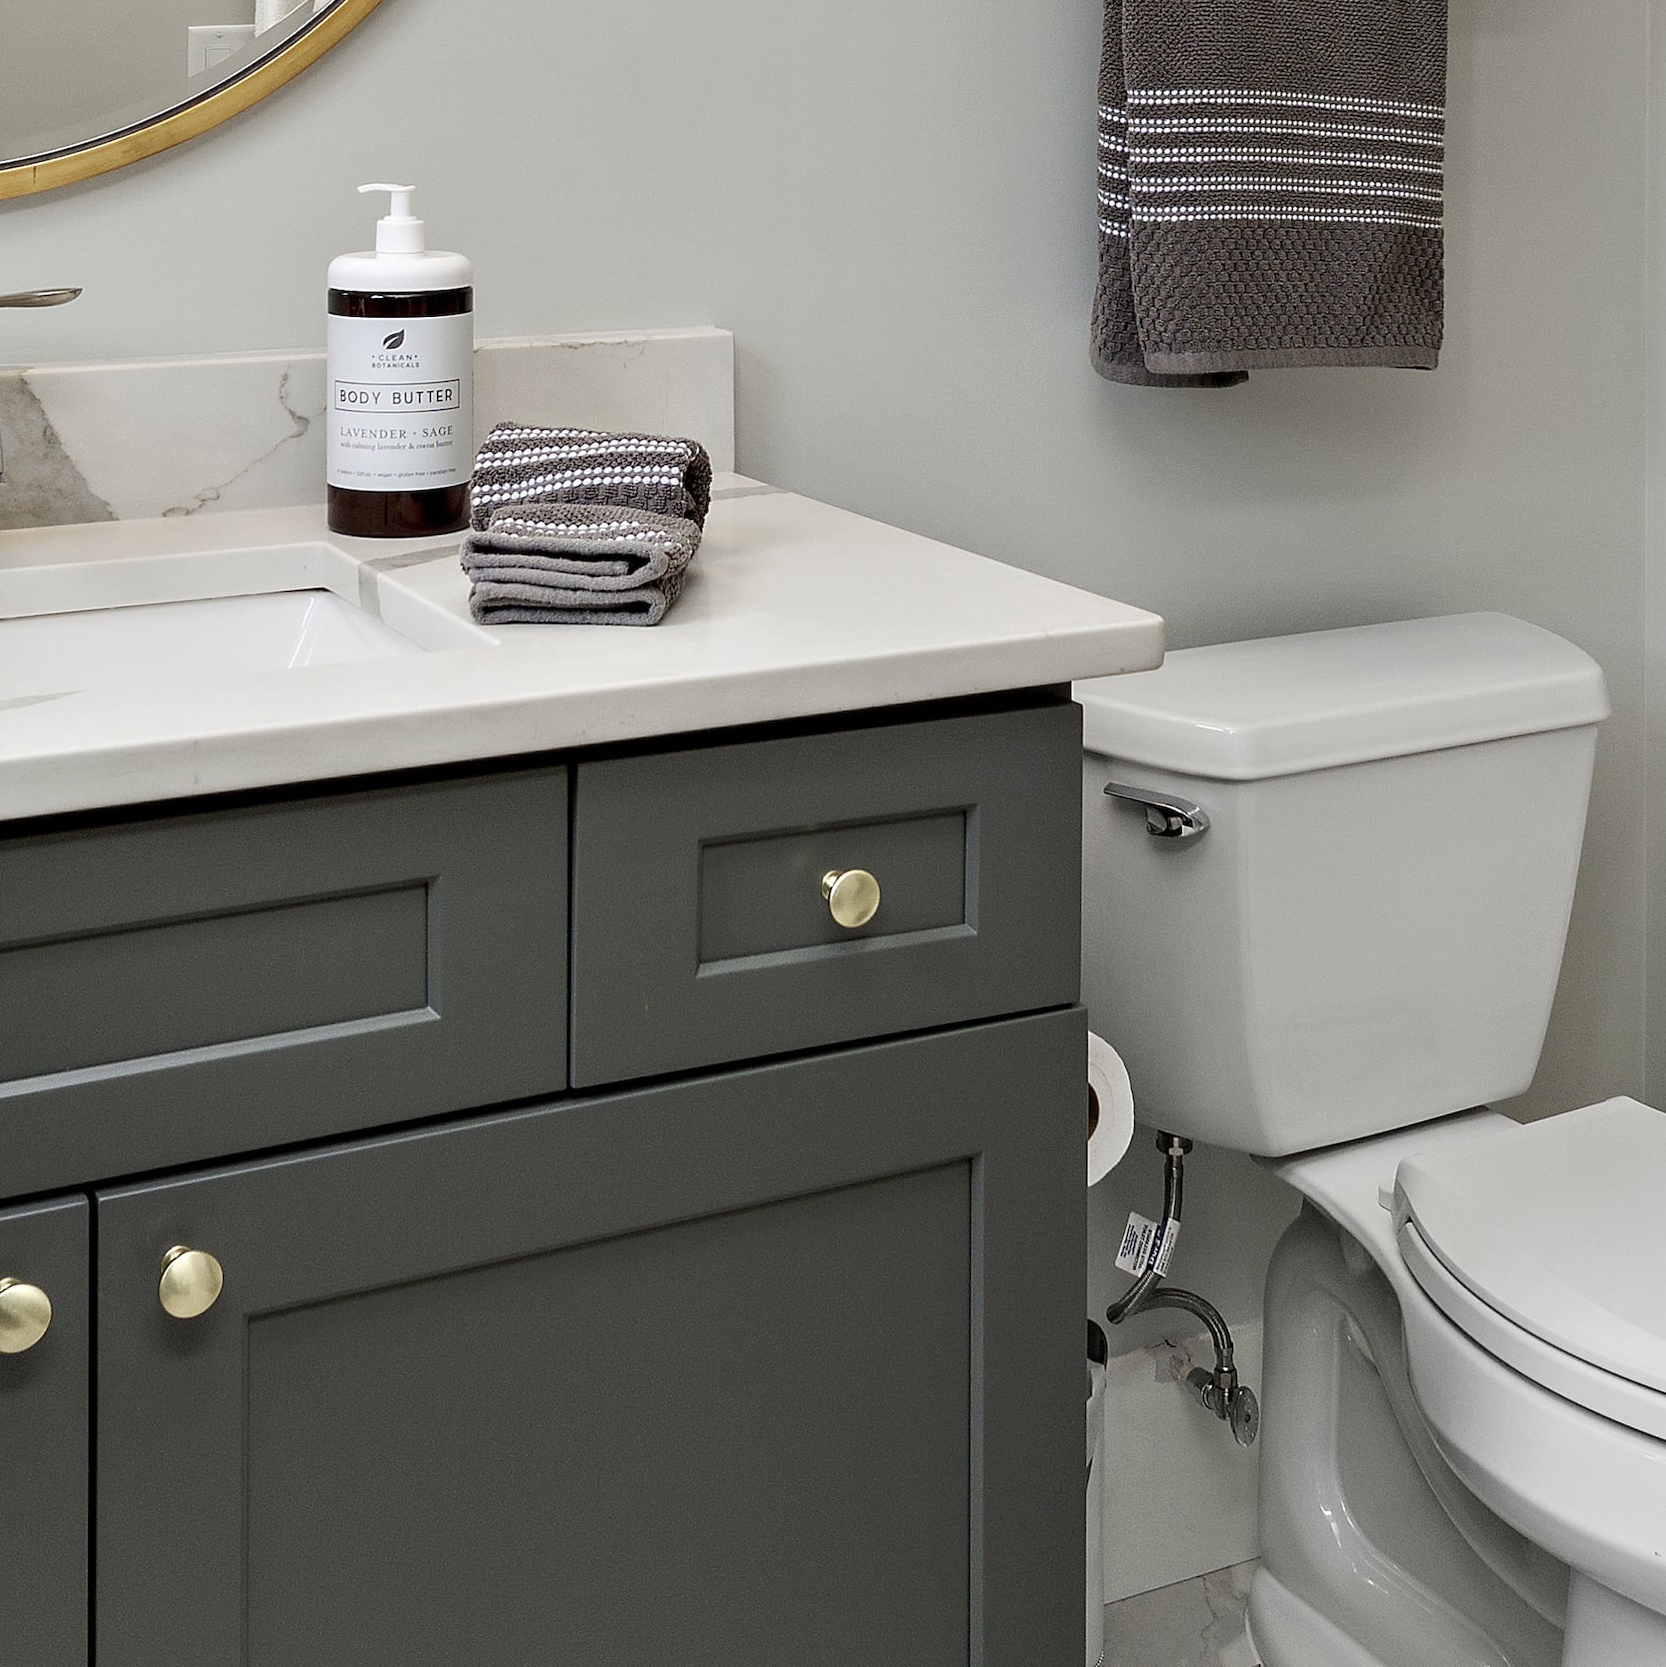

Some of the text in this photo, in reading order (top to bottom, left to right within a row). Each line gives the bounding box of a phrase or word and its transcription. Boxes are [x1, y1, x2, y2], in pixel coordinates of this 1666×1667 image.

[340, 388, 453, 404] BODY BUTTER
[340, 425, 453, 439] LAVENDER SAGE
[377, 442, 407, 450] lavender
